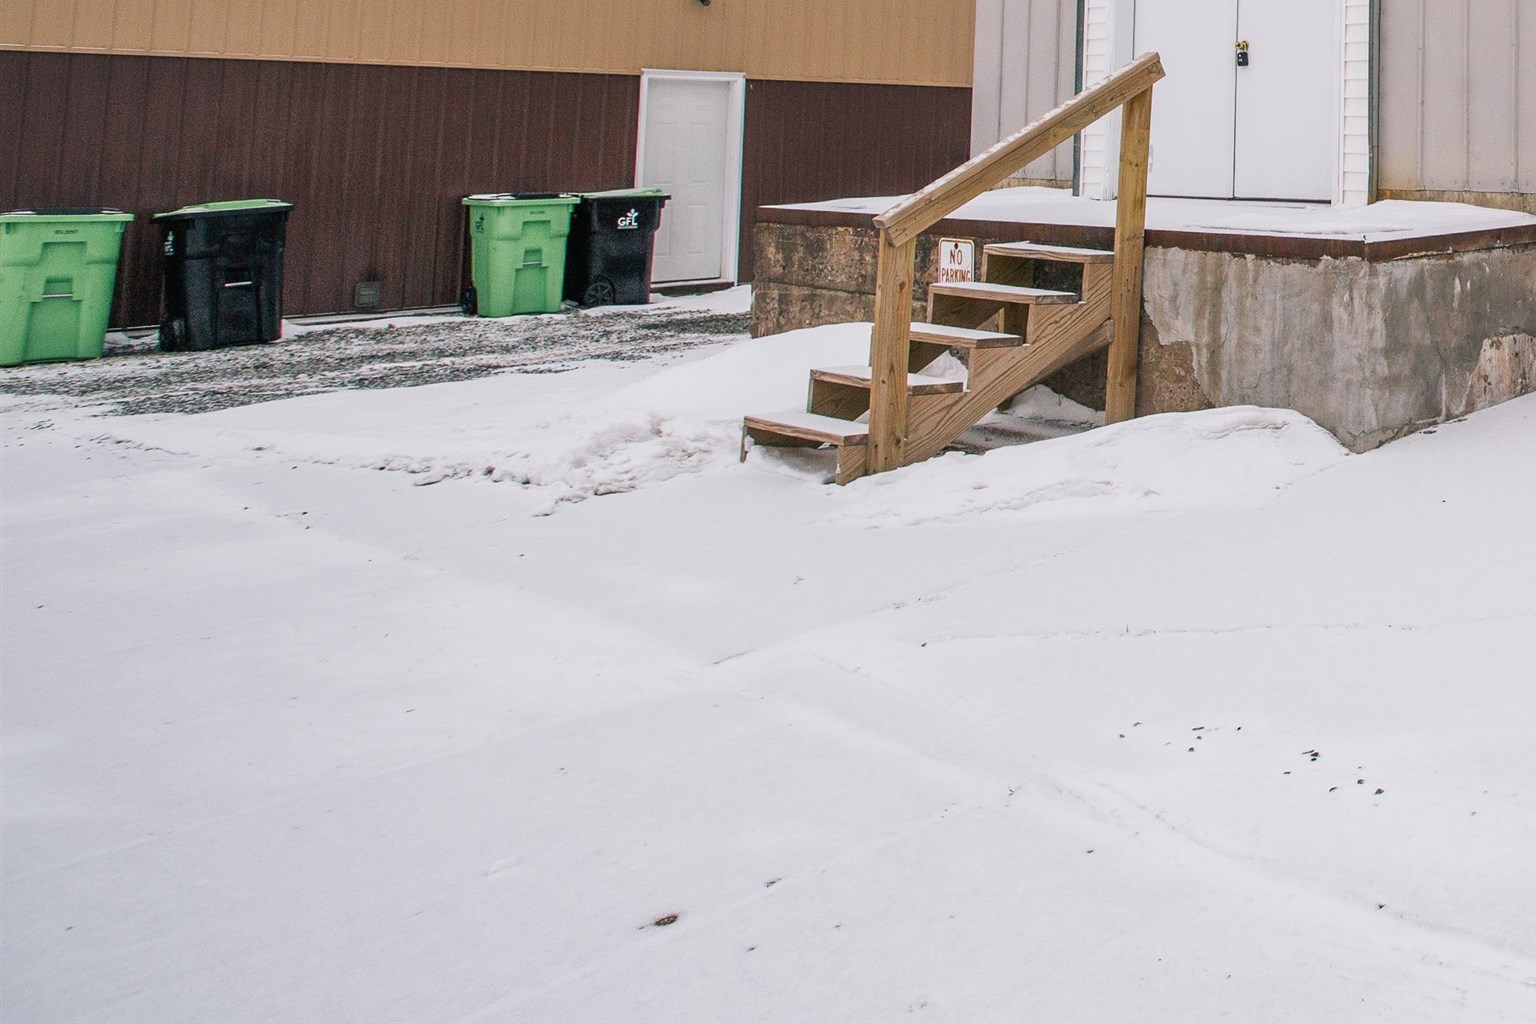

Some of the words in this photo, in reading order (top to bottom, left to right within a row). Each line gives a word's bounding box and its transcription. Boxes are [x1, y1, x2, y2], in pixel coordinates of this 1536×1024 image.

[617, 215, 638, 226] GFL
[949, 249, 963, 265] NO
[941, 267, 971, 282] PARKING
